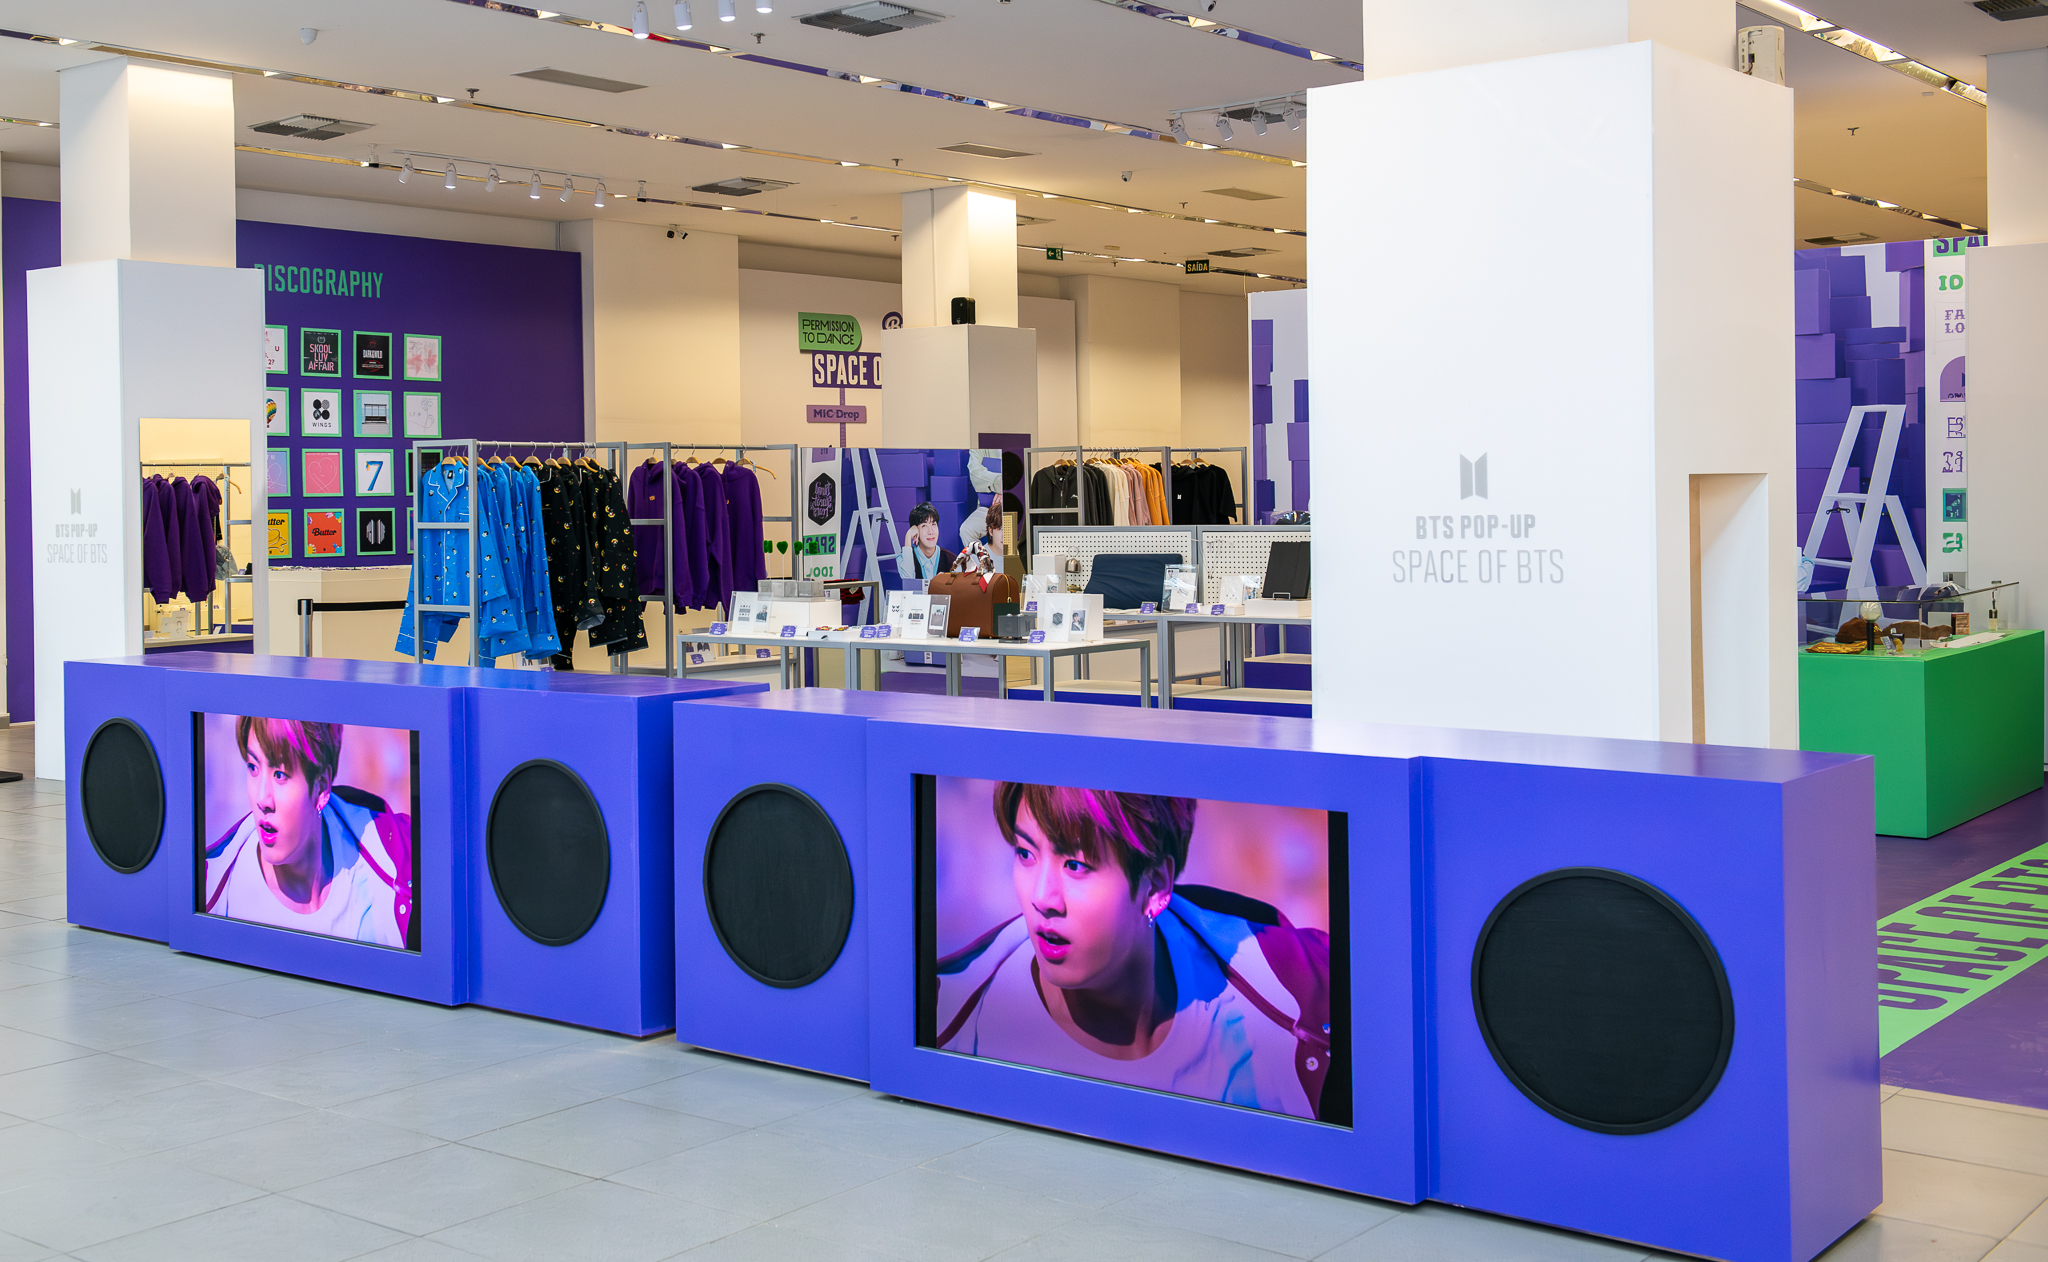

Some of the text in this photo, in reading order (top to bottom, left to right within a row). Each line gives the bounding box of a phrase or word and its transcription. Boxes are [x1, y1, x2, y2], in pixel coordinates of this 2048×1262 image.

[1187, 261, 1208, 272] SAÍDA
[254, 263, 383, 298] ISCOGRAPHY
[802, 319, 855, 333] PERMISSION
[802, 332, 855, 345] TO DANCE
[309, 343, 333, 354] SKOOL
[314, 353, 328, 362] LUV
[308, 361, 335, 371] AFFAIR
[814, 353, 882, 386] SPACE O
[835, 408, 860, 421] Drop
[365, 460, 384, 491] 7
[268, 518, 285, 526] utter
[1416, 513, 1536, 540] BTS POP-UP
[55, 523, 98, 538] BTS POP-UP
[311, 527, 337, 537] Butter
[47, 543, 108, 564] SPACE OF BTS
[1392, 548, 1564, 584] SPACE OF BTS
